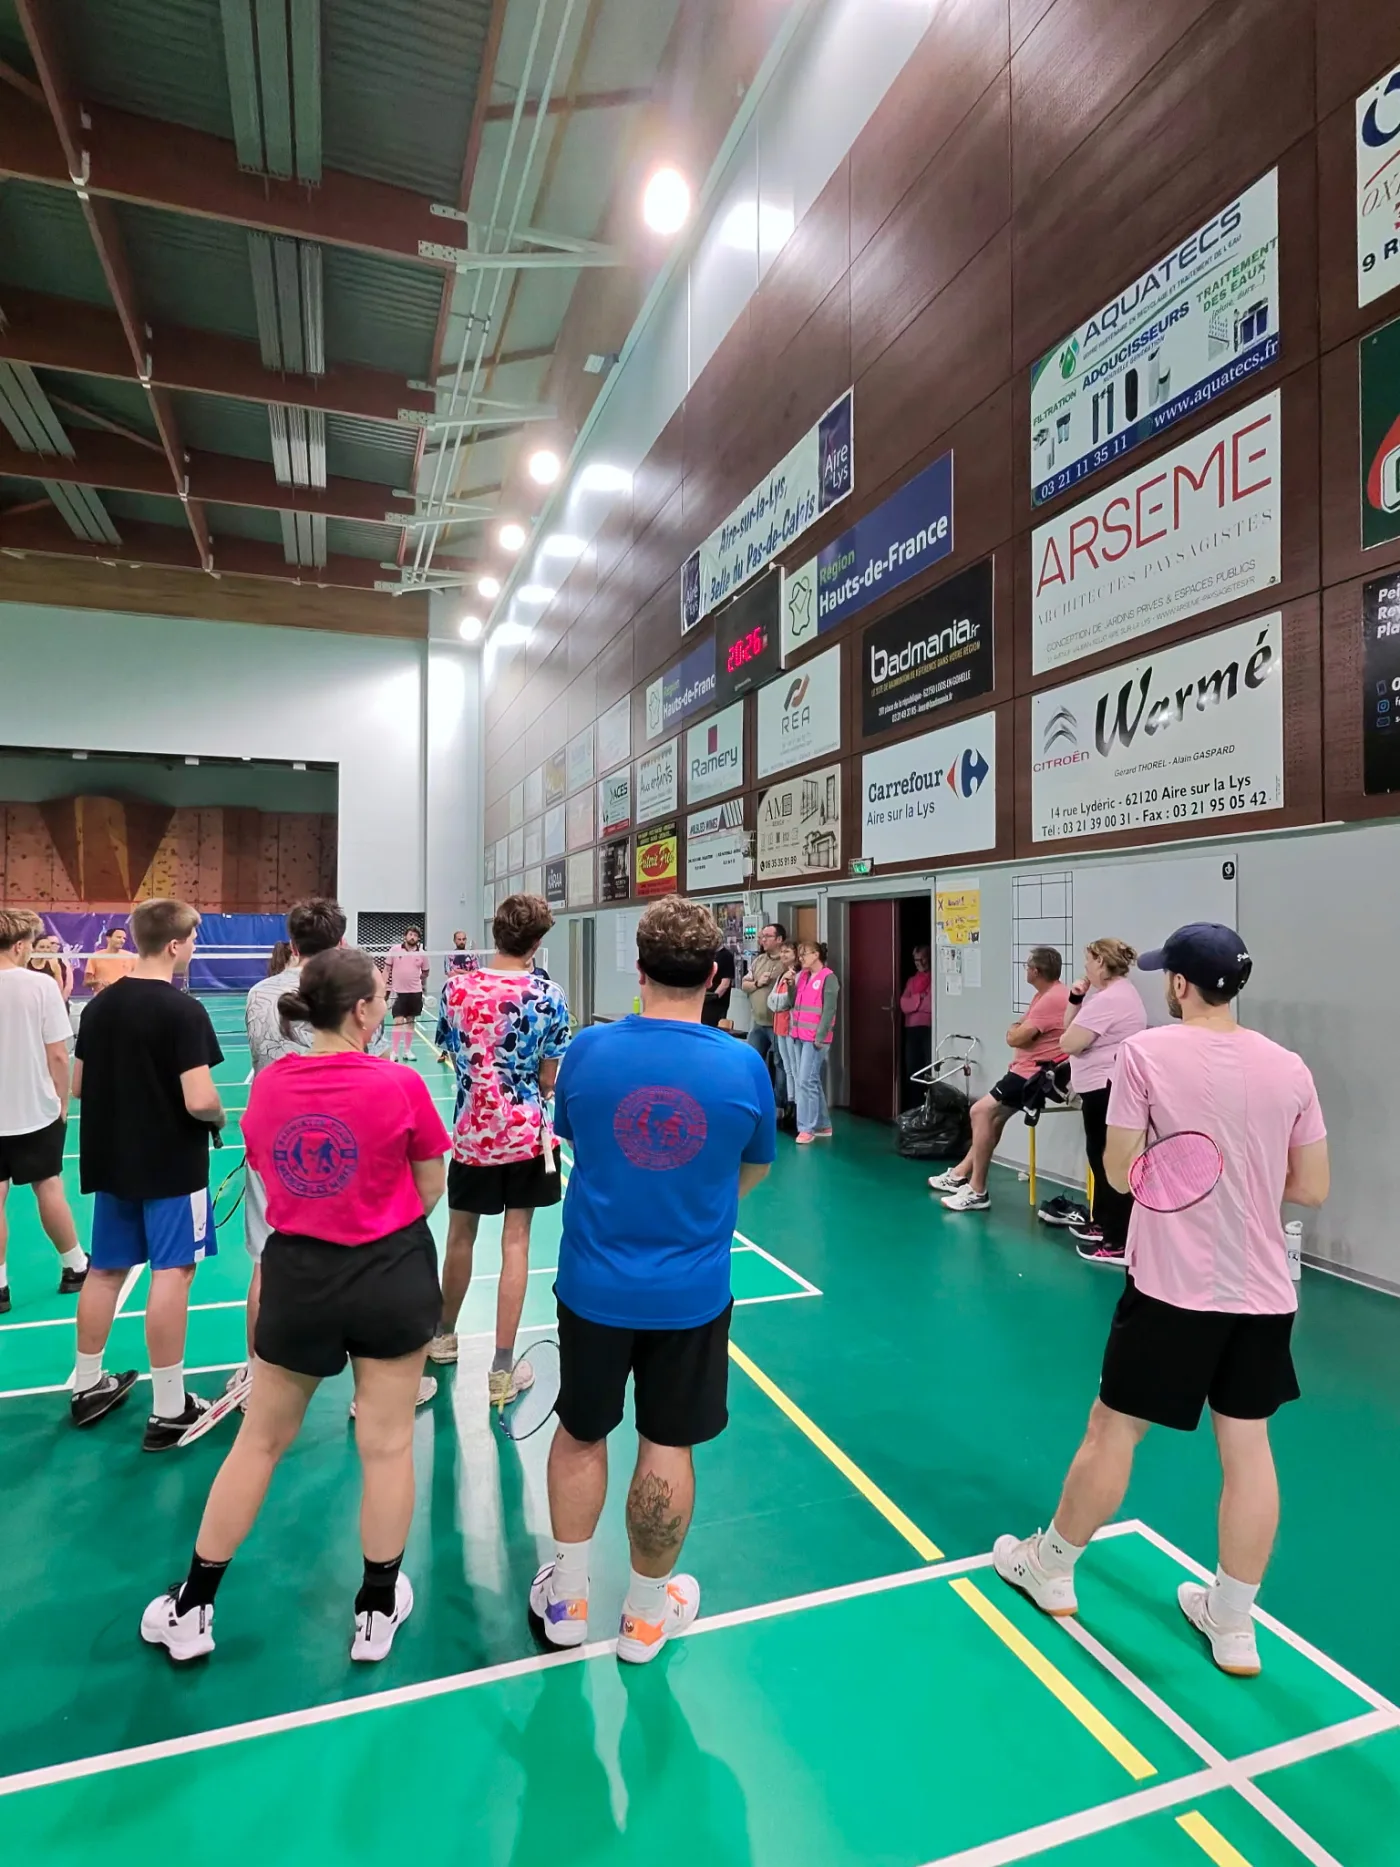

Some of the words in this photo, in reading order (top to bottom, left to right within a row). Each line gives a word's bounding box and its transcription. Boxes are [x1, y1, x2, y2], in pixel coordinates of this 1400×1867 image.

[1083, 202, 1241, 348] AQUATECS
[1178, 256, 1214, 287] TRAITEMENT
[1196, 236, 1278, 302] TRAITEMENT
[1362, 253, 1376, 272] 9
[1384, 238, 1400, 260] R
[1203, 294, 1227, 313] DES
[1231, 259, 1267, 291] EAUX
[1082, 302, 1190, 390] ADOUCISSEURS
[1154, 339, 1279, 428] www.aquatecs.fr
[1033, 389, 1077, 427] FILTRATION
[824, 443, 848, 477] Aire
[832, 465, 848, 488] Lys
[1041, 482, 1055, 499] 03
[1058, 472, 1072, 490] 21
[1076, 459, 1089, 478] 11
[1094, 449, 1109, 466] 35
[1113, 435, 1128, 455] 11
[1036, 414, 1272, 598] ARSEME
[733, 554, 743, 585] du
[747, 489, 816, 573] Pas-de-Calais
[819, 515, 949, 617] Hauts-de-France
[1038, 573, 1136, 627] ARCHITECTES
[1144, 509, 1273, 580] PAYSAGISTES
[1046, 627, 1092, 653] CONCEPTION
[1093, 622, 1102, 635] DE
[1104, 610, 1135, 631] JARDINS
[1174, 577, 1214, 601] ESPACES
[1216, 559, 1256, 584] PUBLICS
[727, 626, 762, 673] 20:26
[663, 673, 717, 719] Hauts-de-Franc
[1095, 628, 1272, 758] Warmé
[781, 705, 811, 735] REA
[691, 746, 738, 780] Ramery
[1033, 750, 1090, 773] CITROËN
[1138, 759, 1167, 773] THOREL
[1172, 754, 1192, 766] Alain
[1193, 744, 1236, 761] GASPARD
[868, 769, 944, 804] Carrefour
[1051, 806, 1060, 819] 14
[1063, 806, 1078, 818] rue
[1080, 798, 1116, 816] Lydéric
[1125, 788, 1158, 807] 62120
[1161, 783, 1187, 800] Aire
[1190, 782, 1211, 796] sur
[1214, 777, 1226, 791] la
[1229, 773, 1252, 792] Lys
[867, 808, 886, 827] Aire
[887, 809, 903, 822] sur
[905, 804, 915, 819] la
[917, 800, 936, 821] Lys
[1063, 821, 1074, 834] 03
[1077, 819, 1086, 832] 21
[1090, 816, 1102, 830] 39
[1105, 814, 1117, 828] 00
[1120, 811, 1131, 825] 31
[1143, 807, 1163, 823] Fax
[1173, 803, 1187, 819] 03
[1191, 800, 1205, 816] 21
[1210, 797, 1225, 813] 95
[1229, 794, 1246, 810] 05
[1250, 790, 1267, 806] 42
